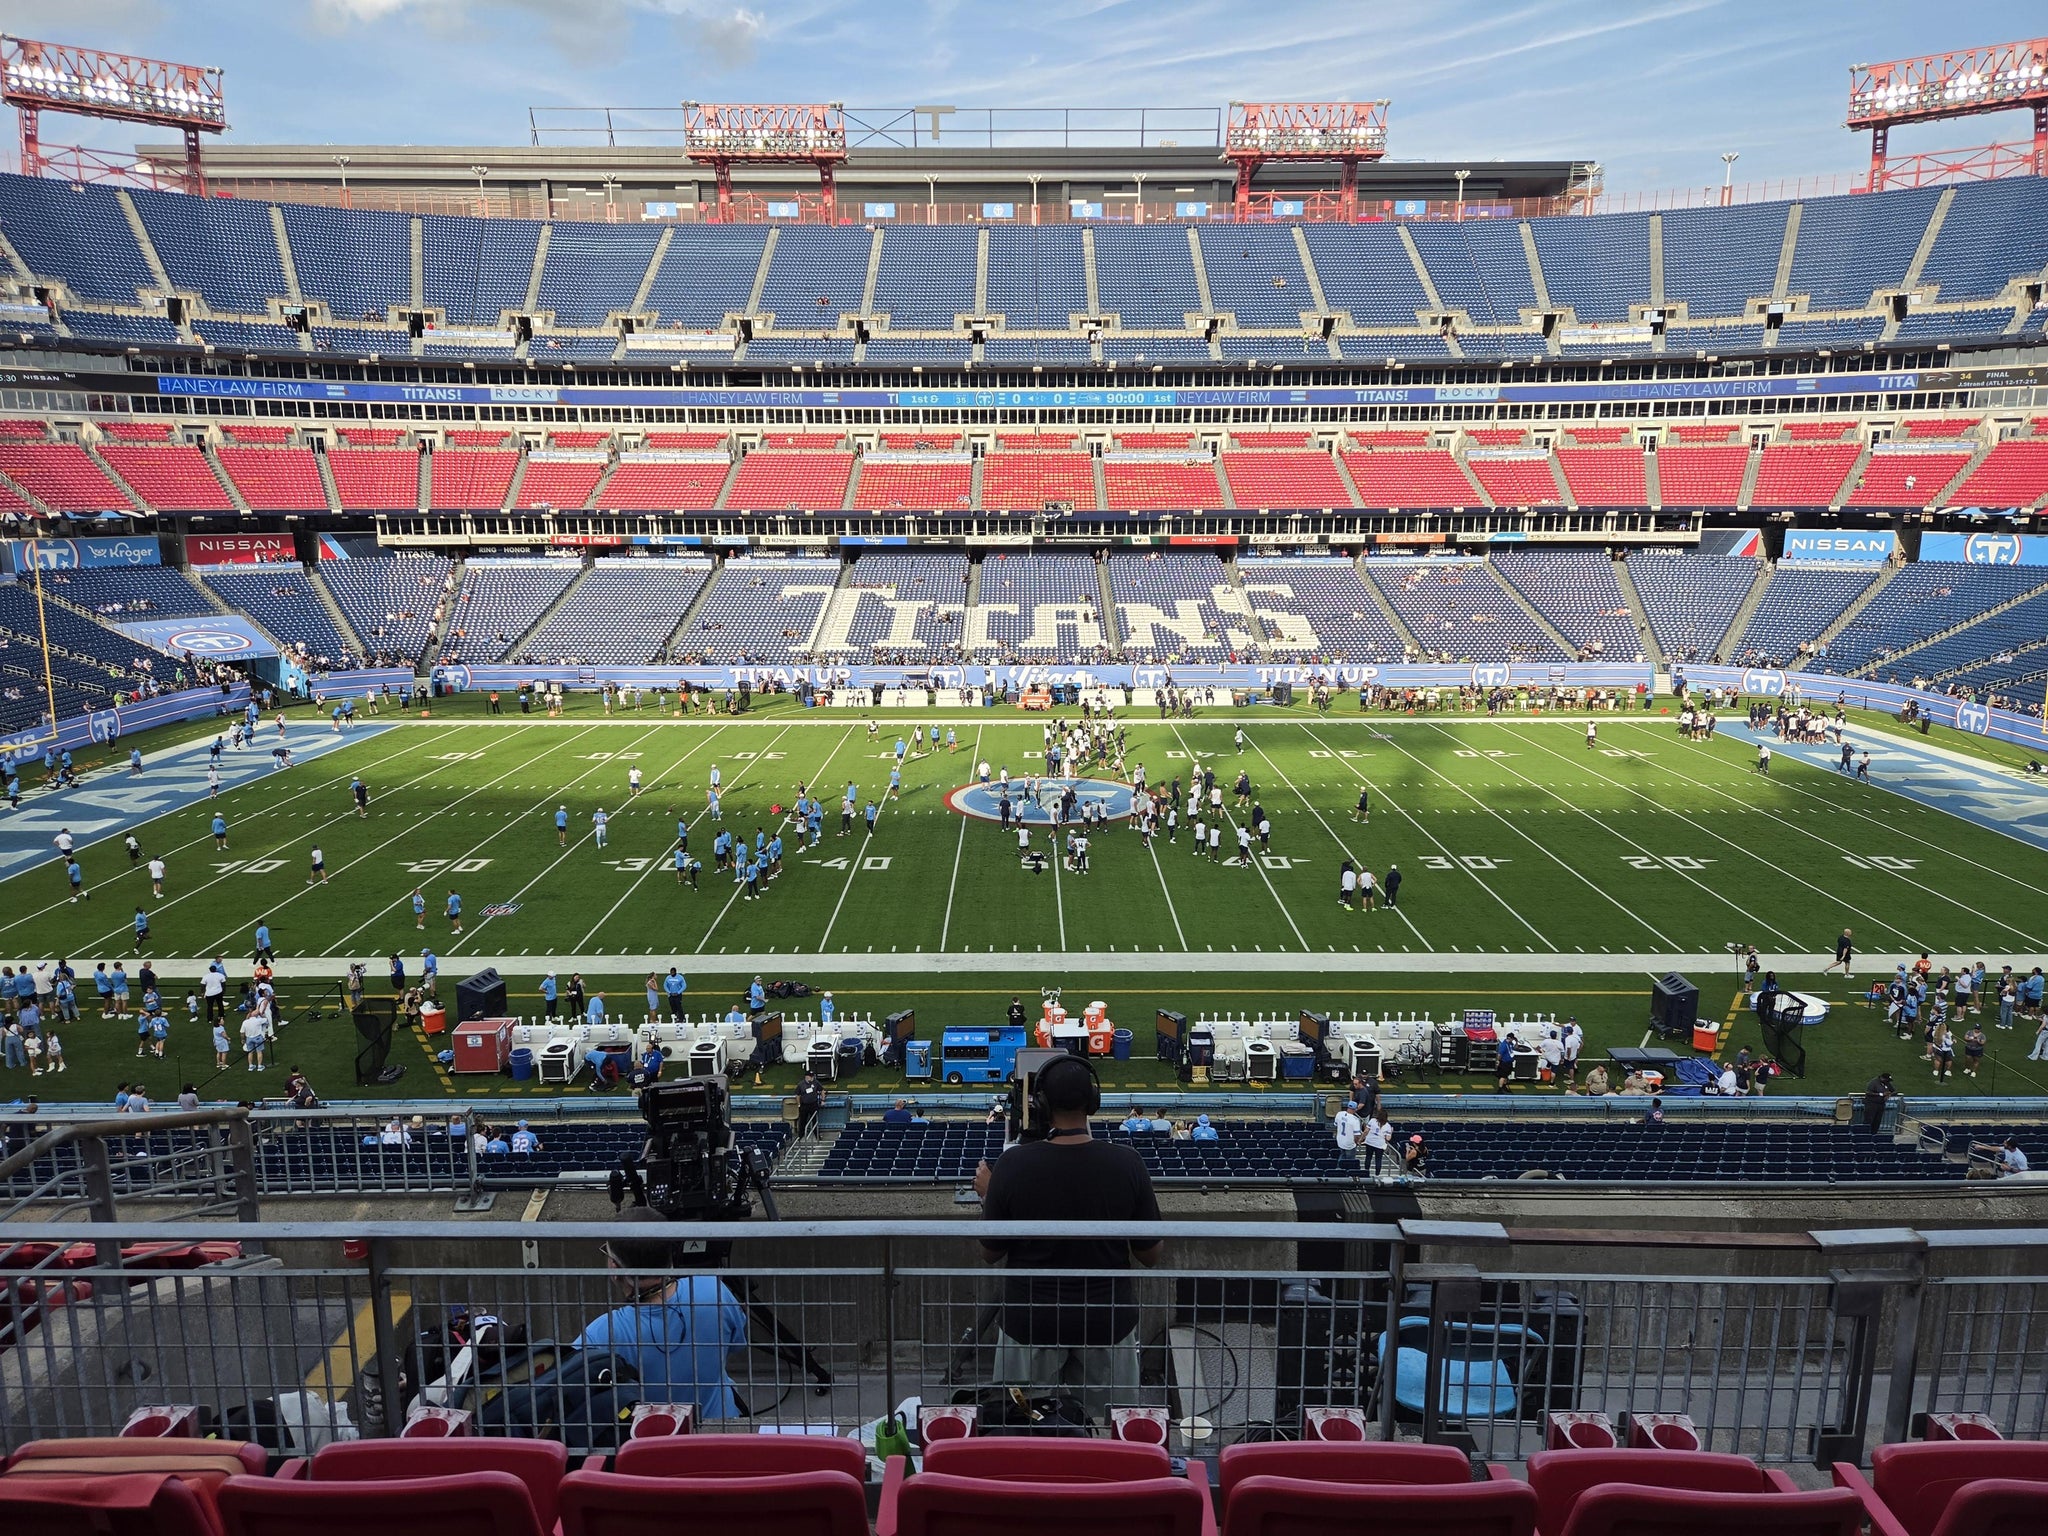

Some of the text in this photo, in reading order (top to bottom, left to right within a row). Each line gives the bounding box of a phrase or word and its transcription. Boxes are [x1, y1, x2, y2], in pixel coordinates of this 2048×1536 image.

[1986, 371, 2010, 379] FINAL
[1733, 381, 1771, 394] FIRM
[1878, 375, 1916, 389] TITA
[263, 383, 302, 396] FIRM
[402, 387, 462, 400] TITANS!
[496, 389, 553, 398] ROCKY
[1355, 389, 1408, 401] TITANS!
[1440, 387, 1496, 397] ROCKY
[771, 393, 802, 404] FIRM
[911, 395, 928, 404] 1st
[1013, 394, 1020, 404] 0
[1054, 394, 1062, 404] 0
[1107, 393, 1144, 404] 90:00
[1154, 394, 1171, 403] 1st
[1239, 391, 1270, 402] FIRM
[200, 540, 281, 550] NISSAN
[1791, 539, 1886, 552] NISSAN
[110, 542, 153, 564] Kroger
[394, 551, 435, 559] TITANS
[1642, 548, 1684, 556] TITANS
[782, 584, 1320, 652] TITANS
[141, 622, 230, 633] NISSAN
[213, 652, 258, 661] NISSAN
[729, 667, 853, 684] TITAN UP
[1256, 666, 1379, 684] TITAN UP
[214, 859, 292, 873] 10
[405, 859, 495, 872] 20
[820, 857, 893, 870] 40
[1221, 856, 1292, 869] 40
[1417, 855, 1498, 869] 30
[1619, 856, 1707, 869] 20
[1840, 856, 1917, 869] 10
[1874, 983, 1885, 994] 20
[1090, 1035, 1104, 1050] G
[511, 1138, 530, 1153] 22
